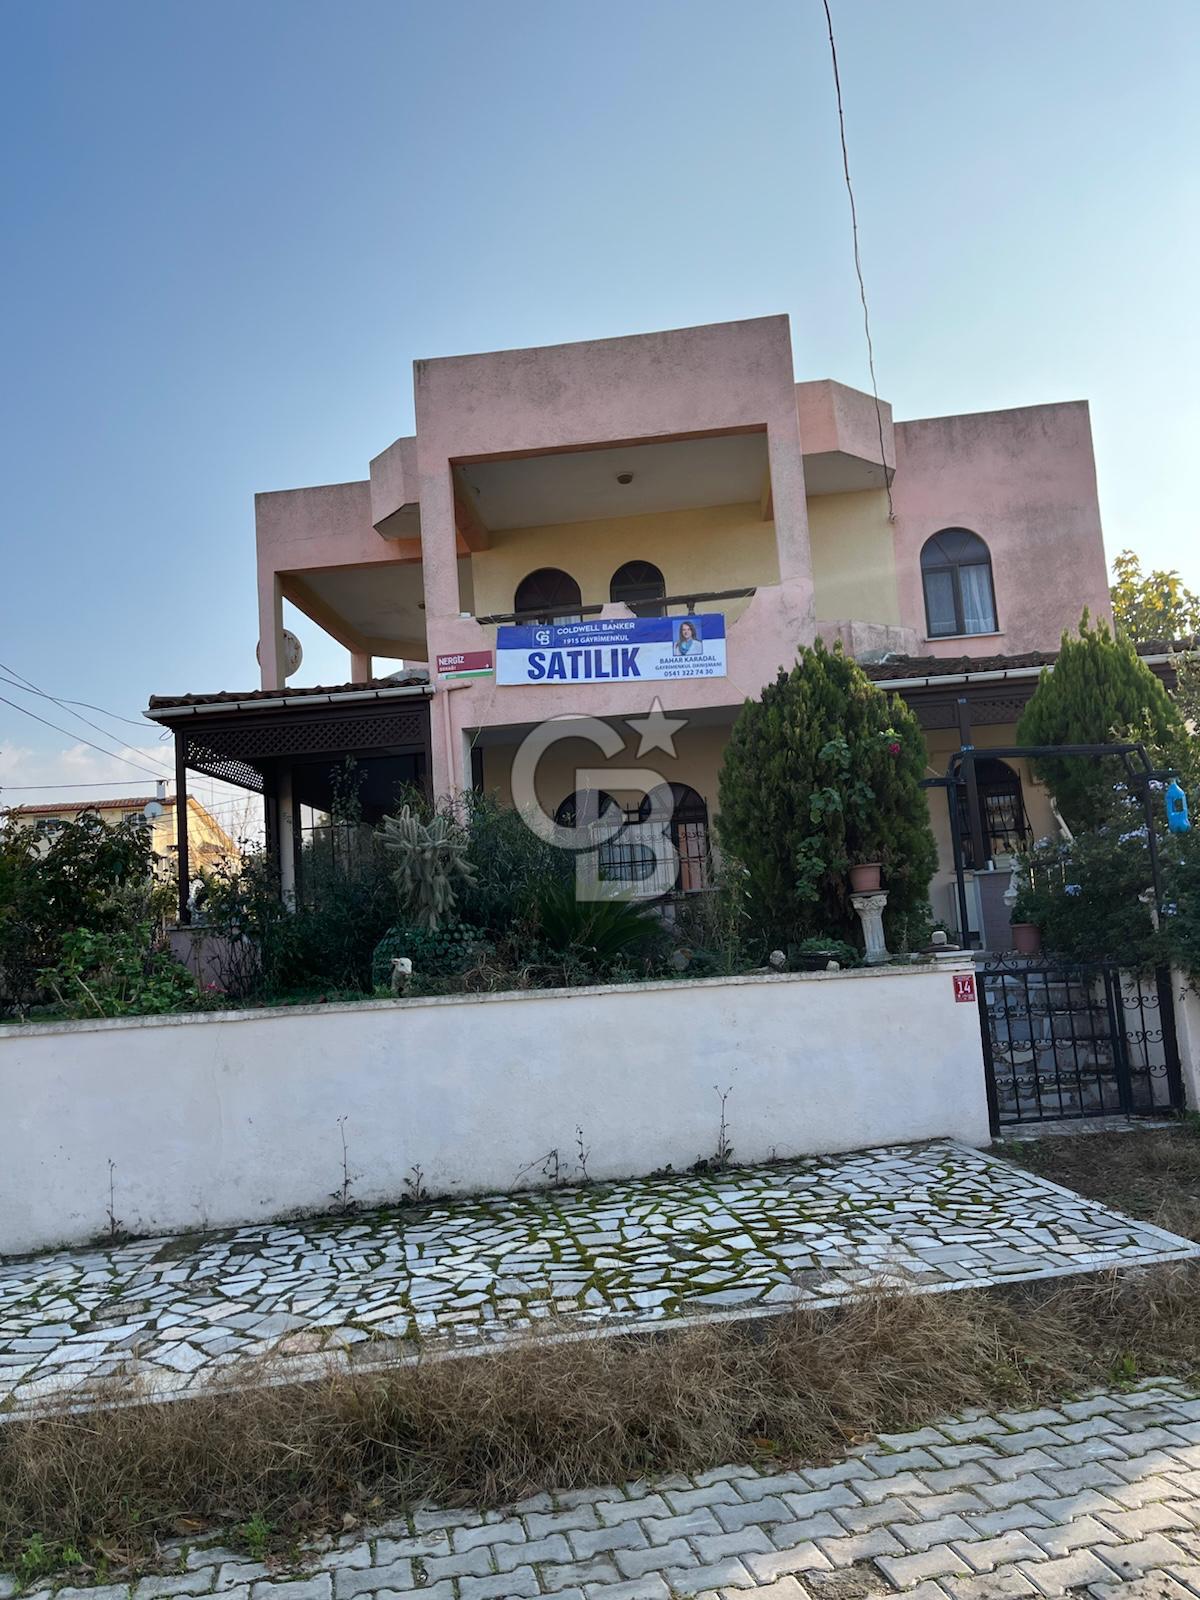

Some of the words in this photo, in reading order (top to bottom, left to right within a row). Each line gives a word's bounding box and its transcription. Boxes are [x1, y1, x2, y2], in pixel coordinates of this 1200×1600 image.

[557, 625, 599, 635] COLDWELL
[602, 622, 635, 631] BANKER
[527, 647, 641, 680] SATILIK
[957, 980, 971, 994] 14
